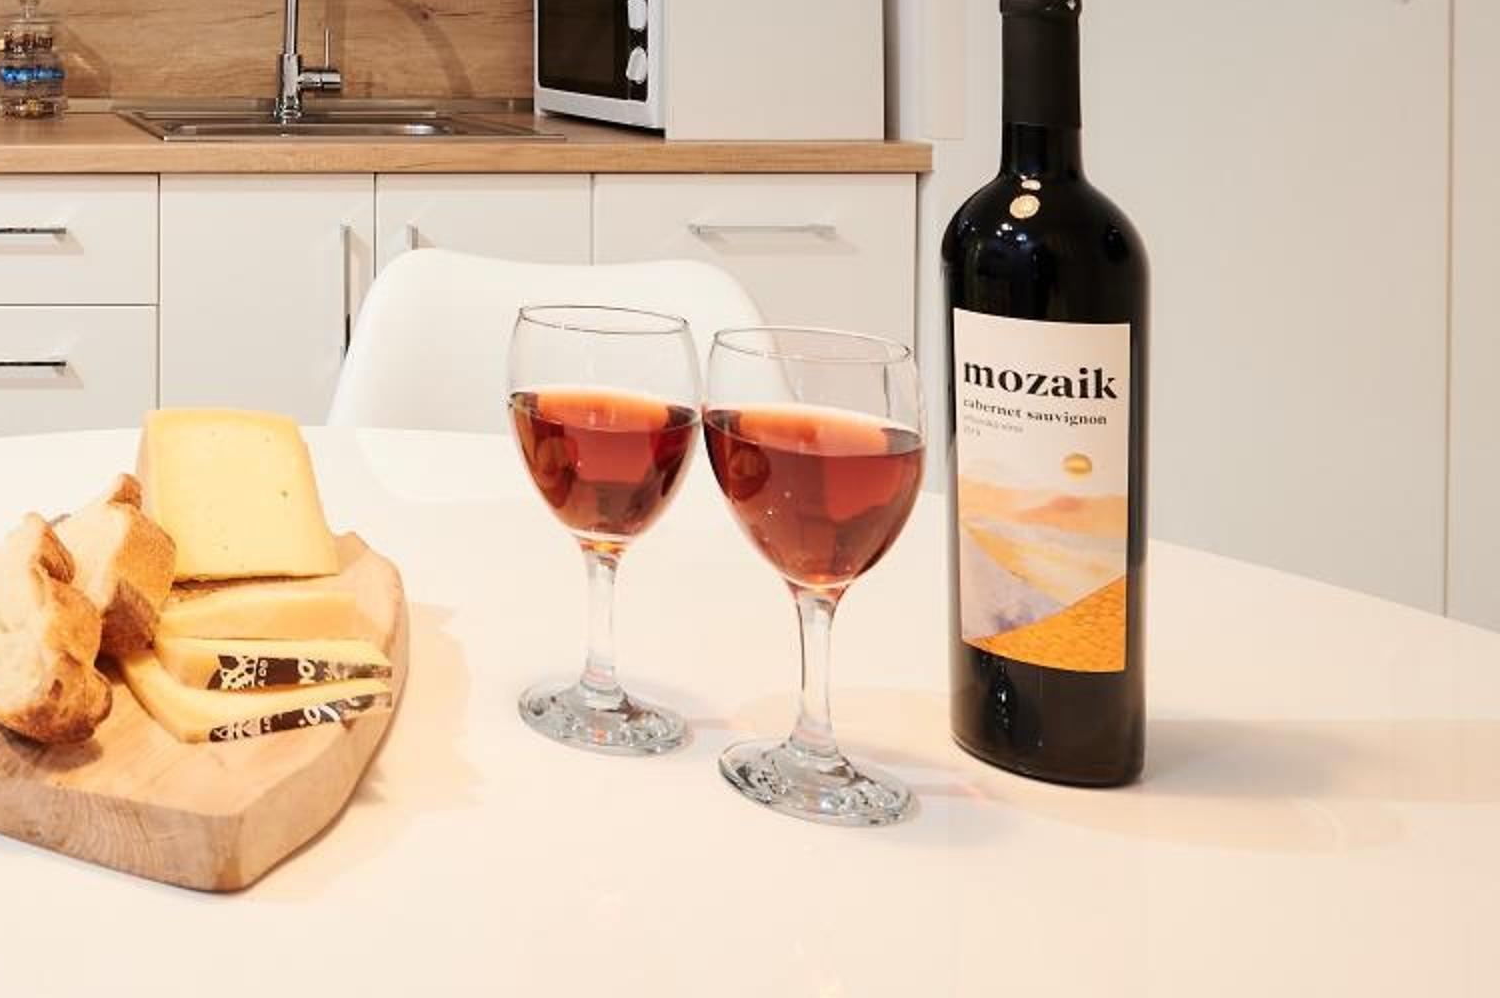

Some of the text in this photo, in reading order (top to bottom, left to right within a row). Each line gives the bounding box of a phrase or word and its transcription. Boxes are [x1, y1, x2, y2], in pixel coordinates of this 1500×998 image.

[963, 361, 1118, 399] mozaik
[963, 398, 1022, 419] cabernet
[1026, 410, 1108, 426] sauvignon
